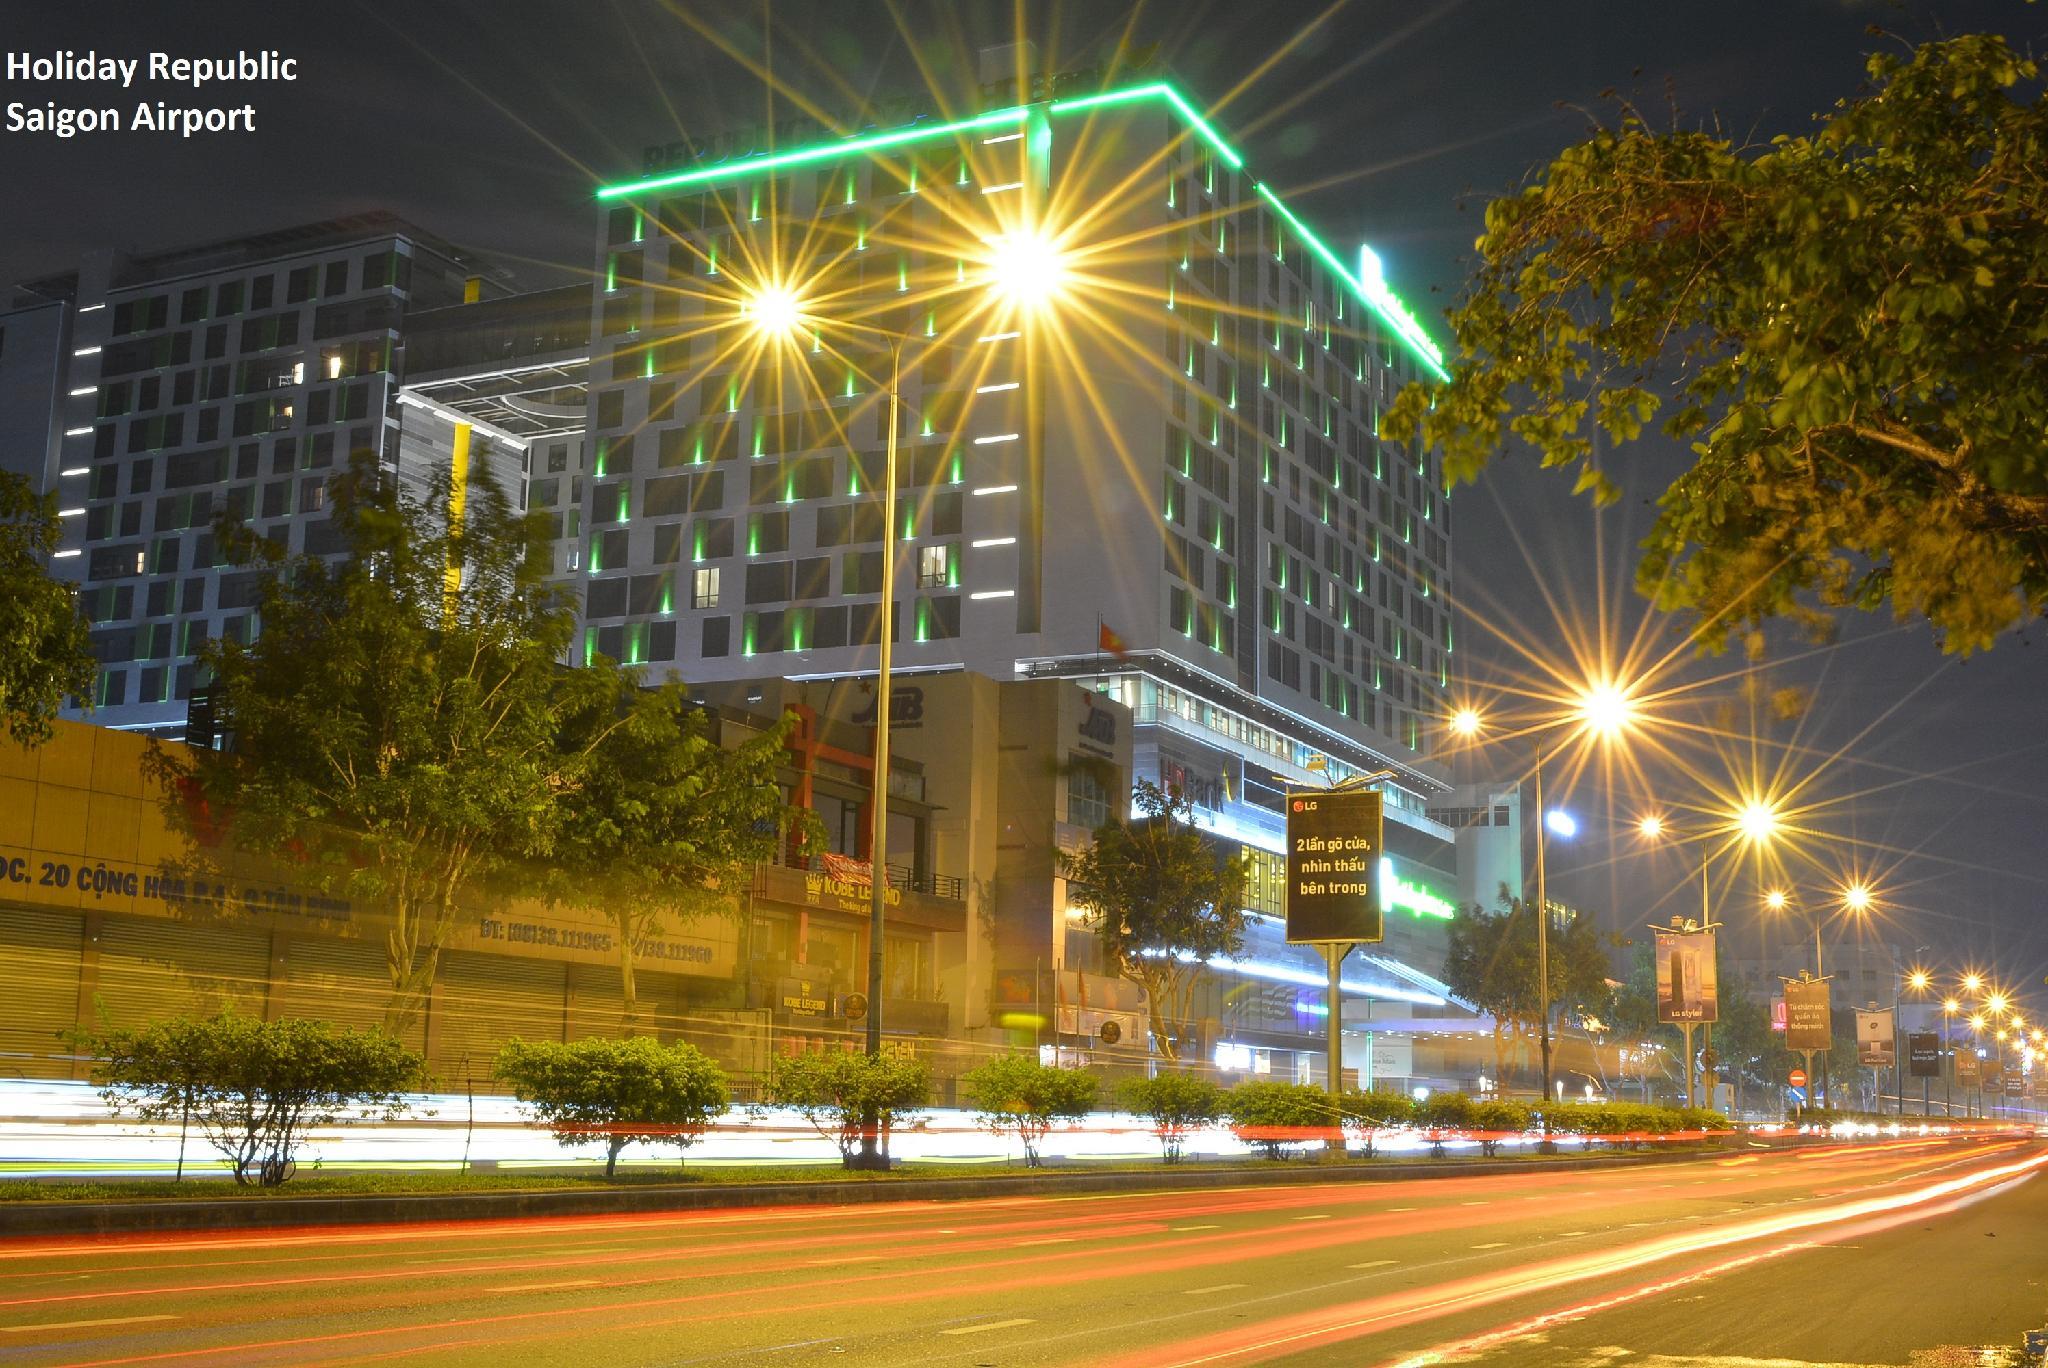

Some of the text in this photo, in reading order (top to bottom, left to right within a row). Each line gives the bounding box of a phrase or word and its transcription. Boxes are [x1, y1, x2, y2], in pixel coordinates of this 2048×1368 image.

[1305, 802, 1317, 811] LG
[1297, 838, 1305, 852] 2
[1306, 836, 1325, 851] lần
[1328, 837, 1342, 853] gõ
[1301, 856, 1366, 873] nhìn thấu
[39, 862, 71, 888] 20
[77, 862, 138, 900] CỘNG
[824, 877, 855, 898] KOBE
[1300, 881, 1367, 896] bên trong
